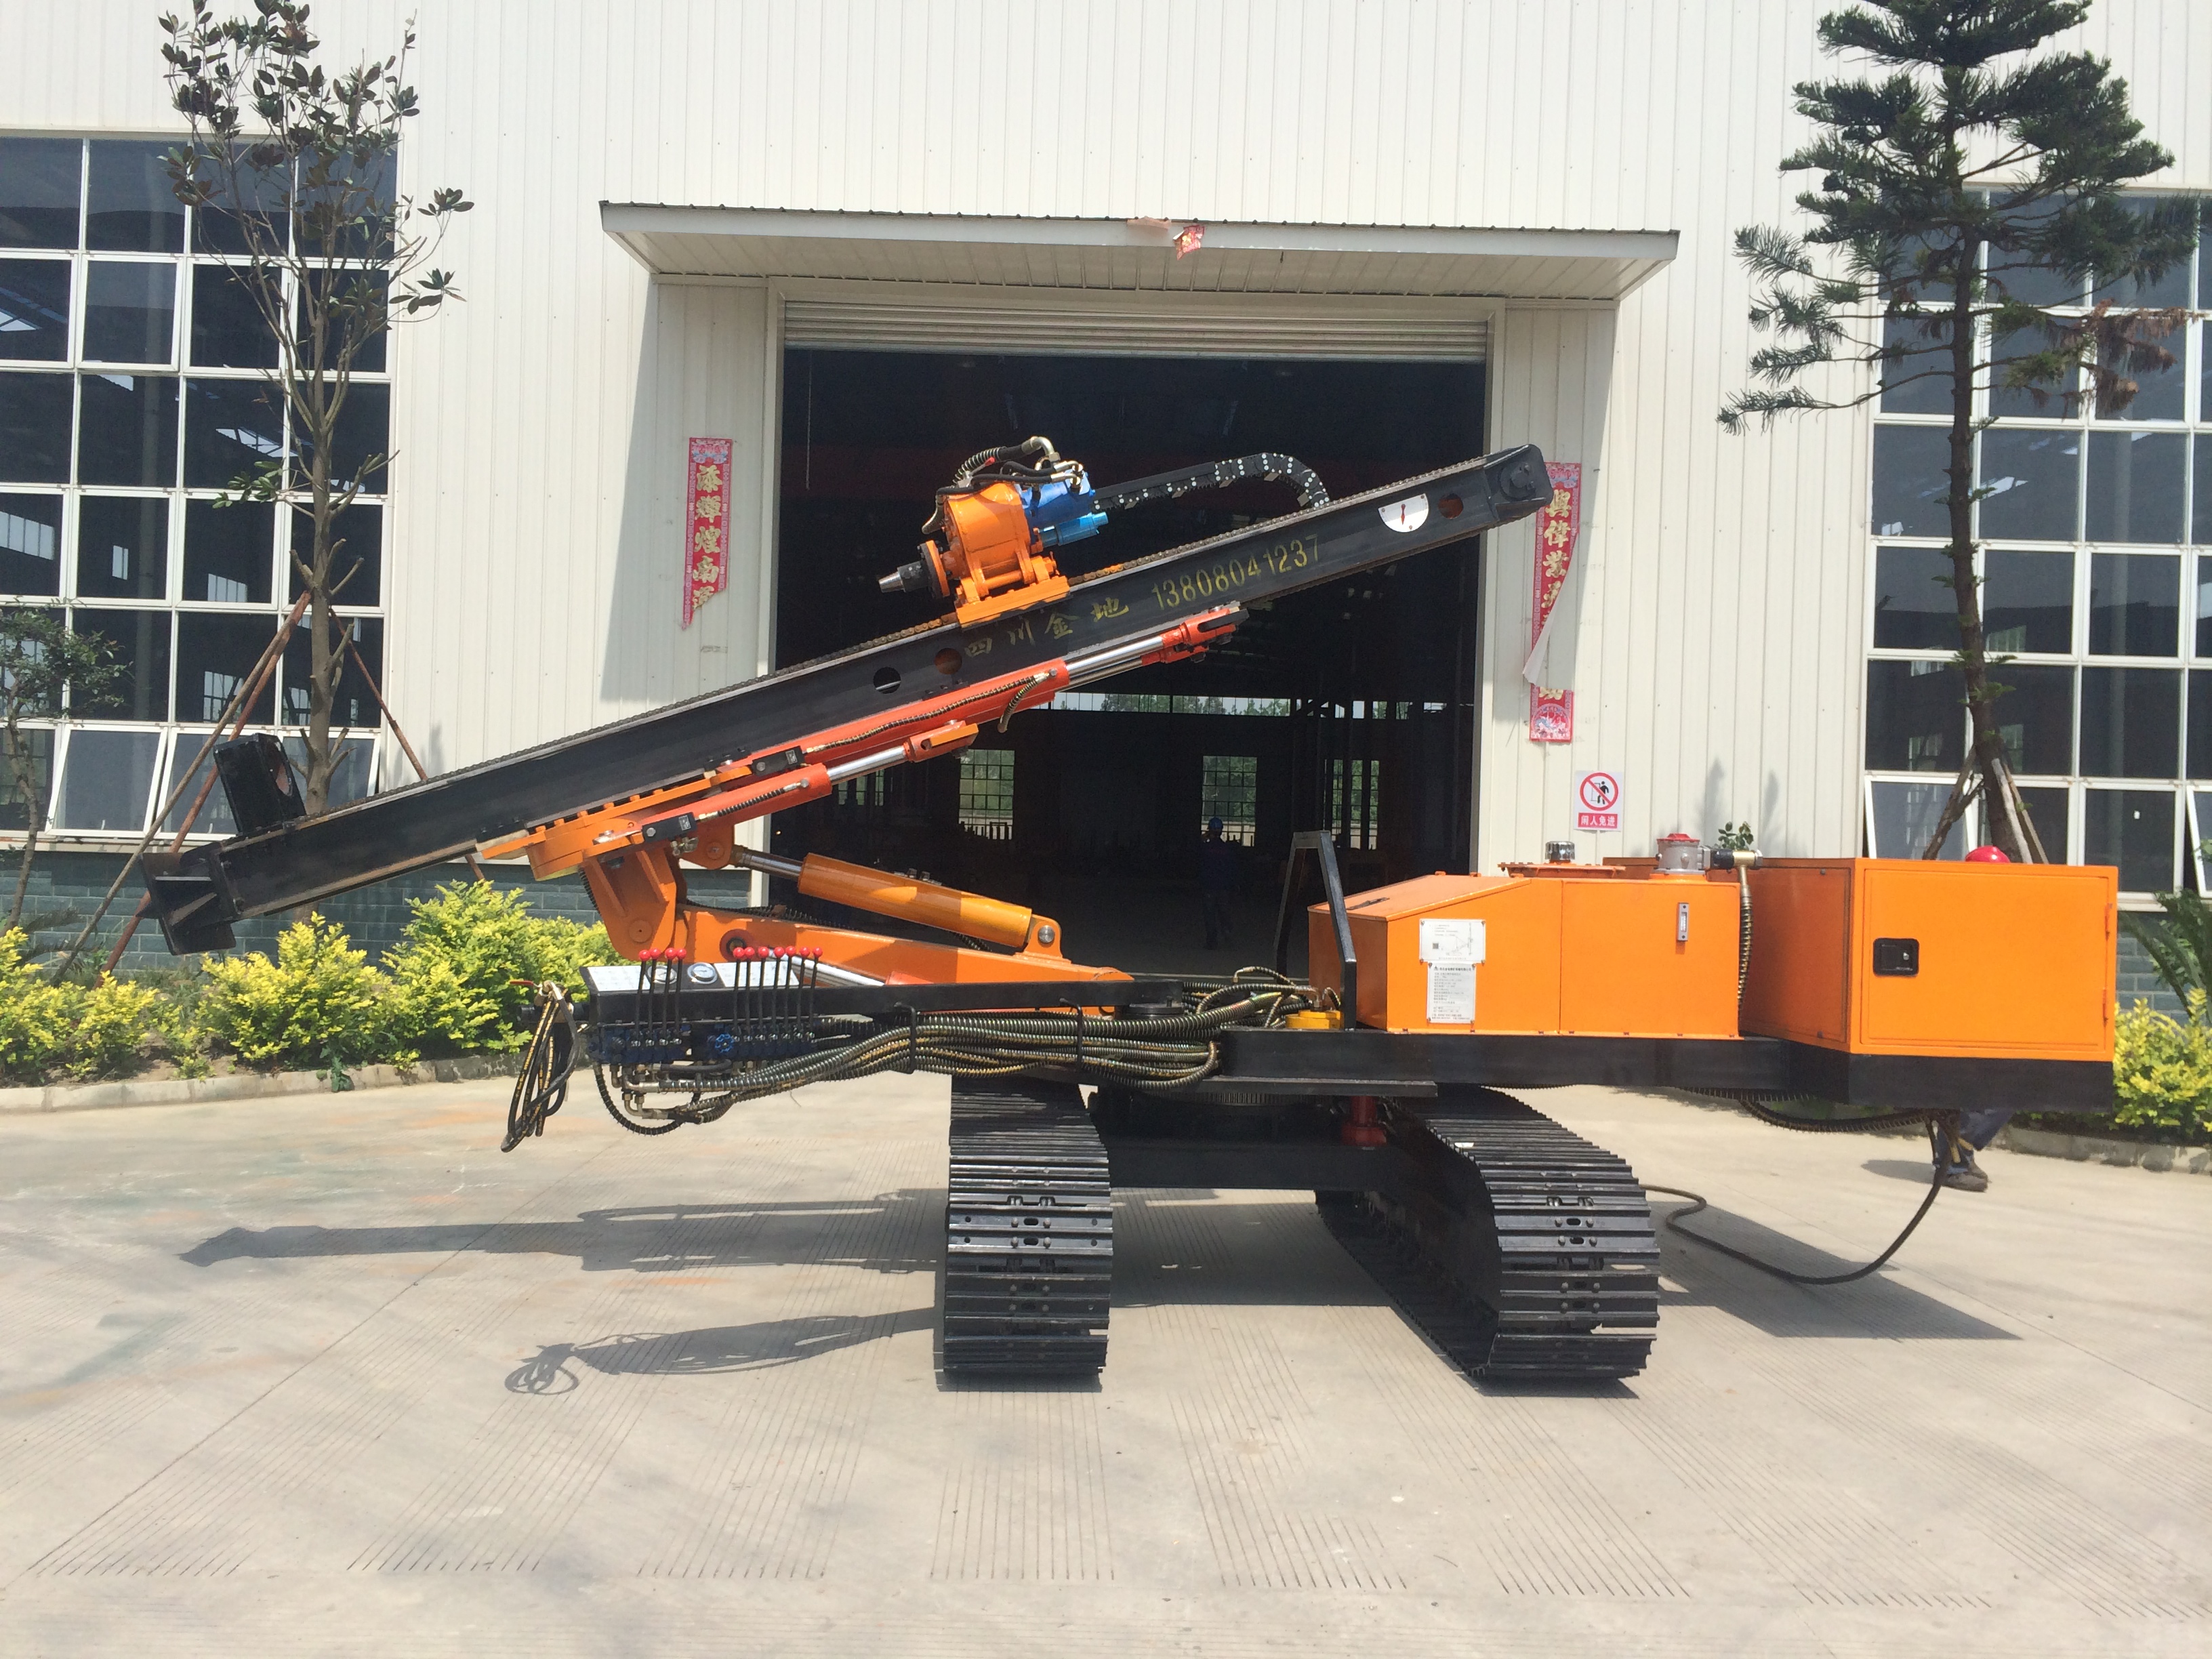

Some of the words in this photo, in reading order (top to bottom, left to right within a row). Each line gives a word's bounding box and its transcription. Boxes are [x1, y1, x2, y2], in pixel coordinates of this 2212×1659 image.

[1153, 533, 1320, 611] 13808041237
[1580, 815, 1616, 827] 闲人免进
